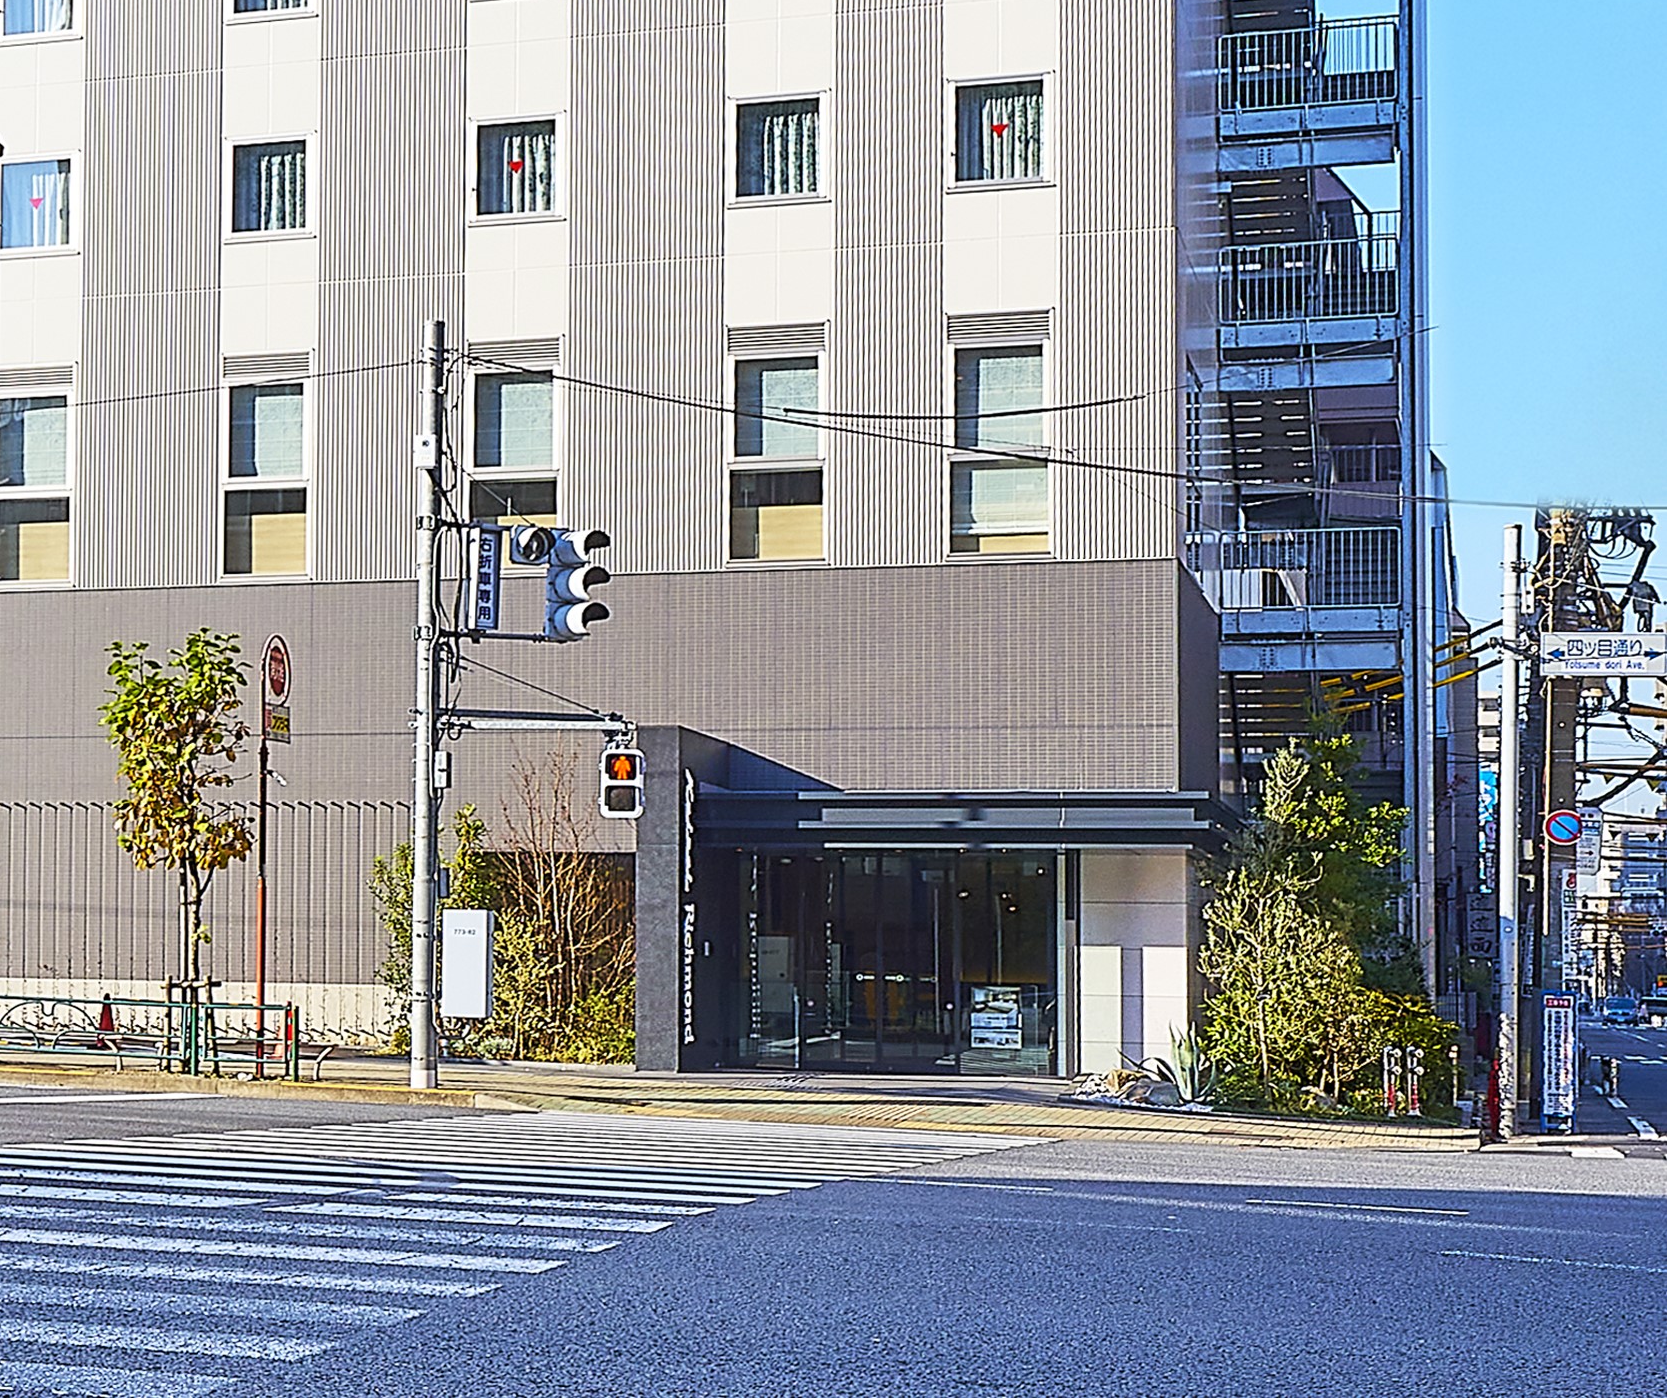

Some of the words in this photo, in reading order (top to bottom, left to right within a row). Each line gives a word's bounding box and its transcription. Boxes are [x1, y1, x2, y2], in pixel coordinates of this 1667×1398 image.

[478, 537, 493, 621] 右折車専用
[1567, 639, 1643, 657] 四ツ目通り
[1626, 660, 1645, 670] Ave.
[684, 903, 695, 1045] Richmond
